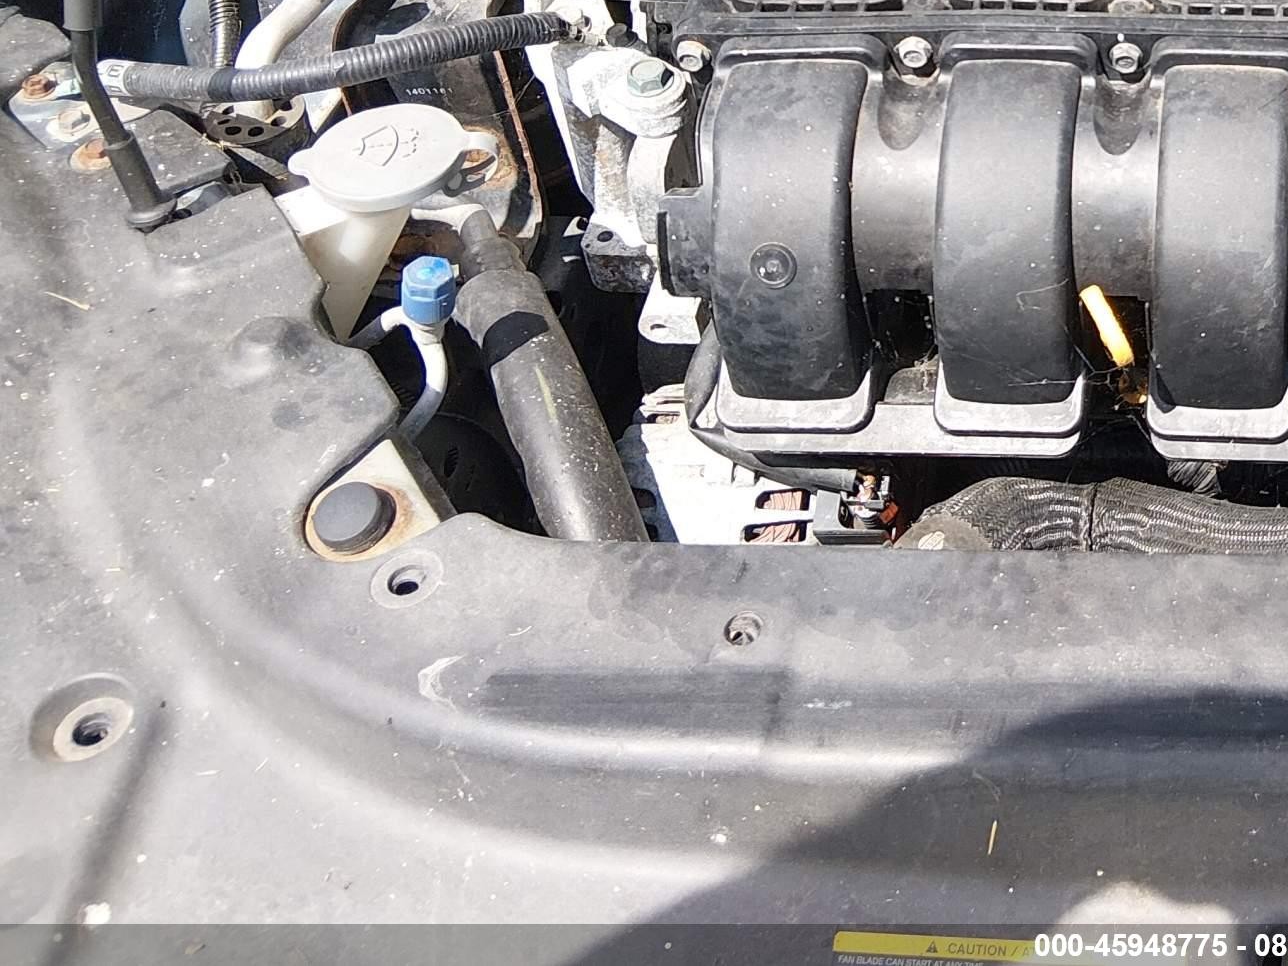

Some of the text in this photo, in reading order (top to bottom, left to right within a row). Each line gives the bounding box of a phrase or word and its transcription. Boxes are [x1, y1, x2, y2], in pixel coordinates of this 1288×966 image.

[947, 942, 1007, 956] CAUTION
[838, 954, 854, 963] FAN
[856, 955, 885, 965] BLADE
[885, 957, 904, 966] CAN
